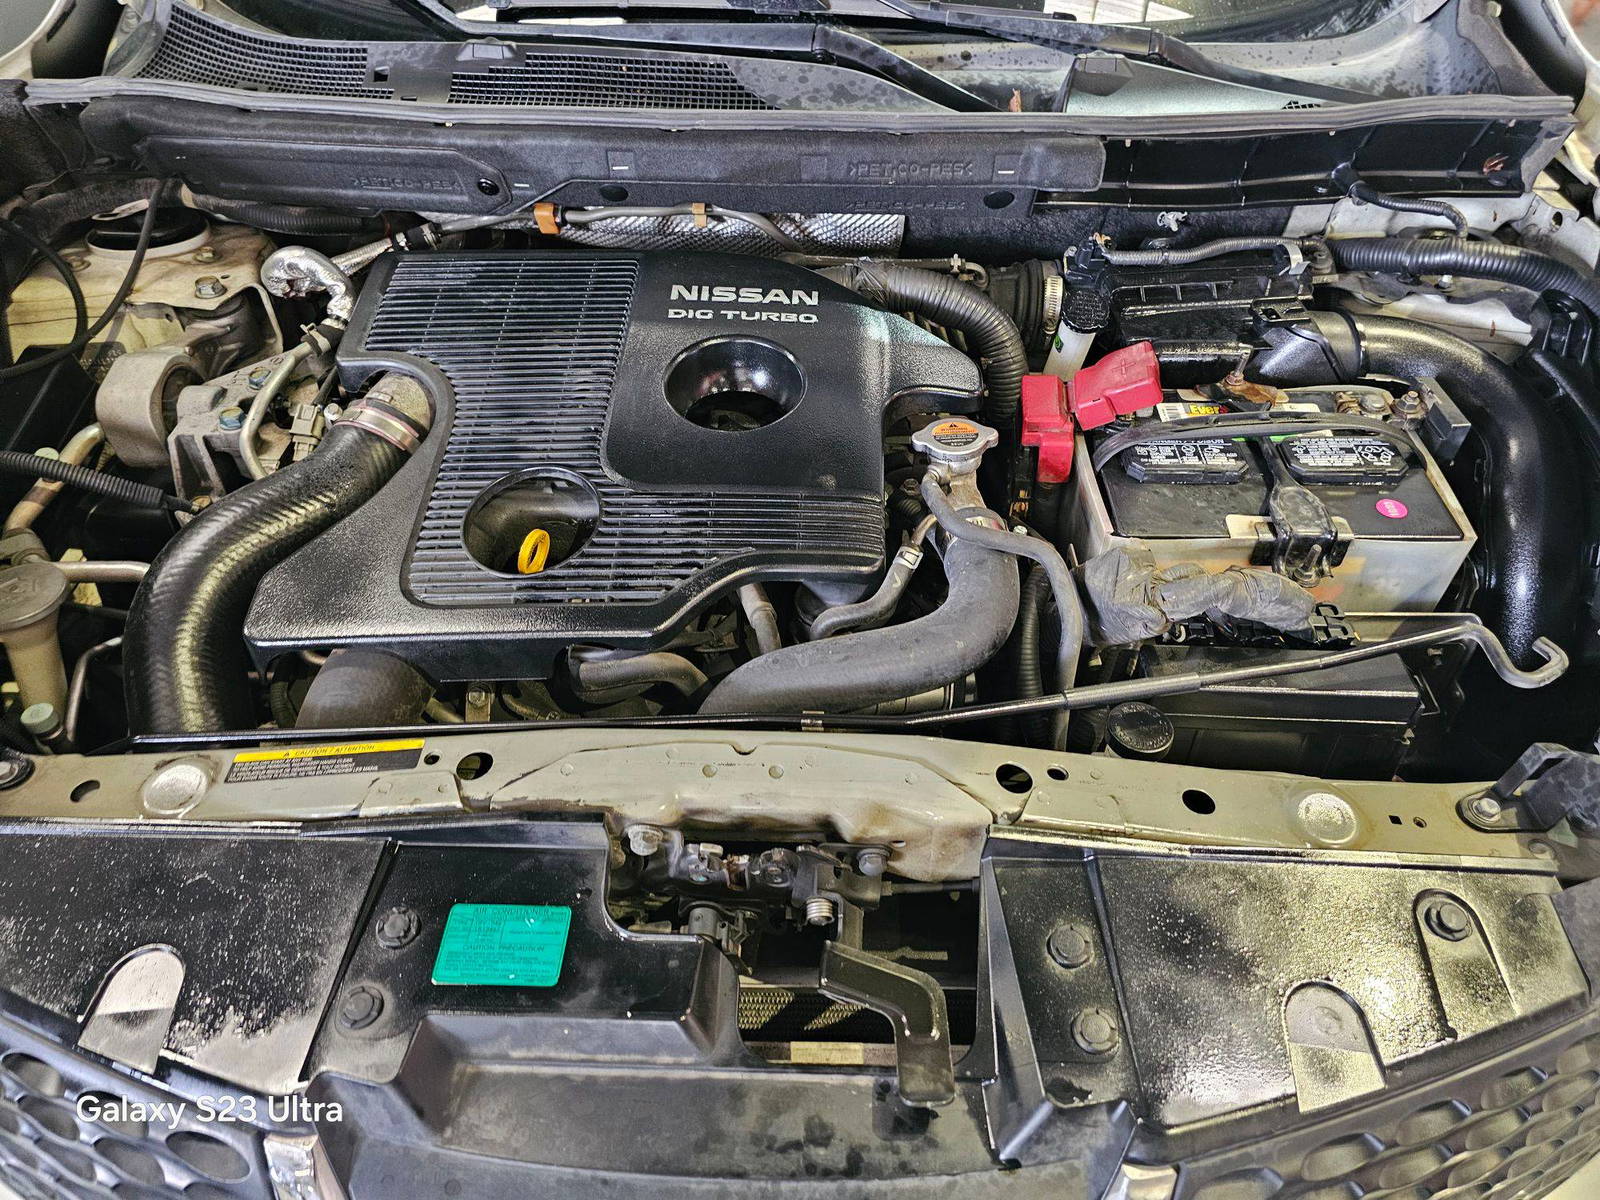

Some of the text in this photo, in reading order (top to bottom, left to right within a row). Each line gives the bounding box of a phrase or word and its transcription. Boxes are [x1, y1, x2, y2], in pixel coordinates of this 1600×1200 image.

[670, 284, 819, 306] NISSAN
[667, 308, 819, 324] DIG TURBO
[335, 745, 375, 753] ATTENTION
